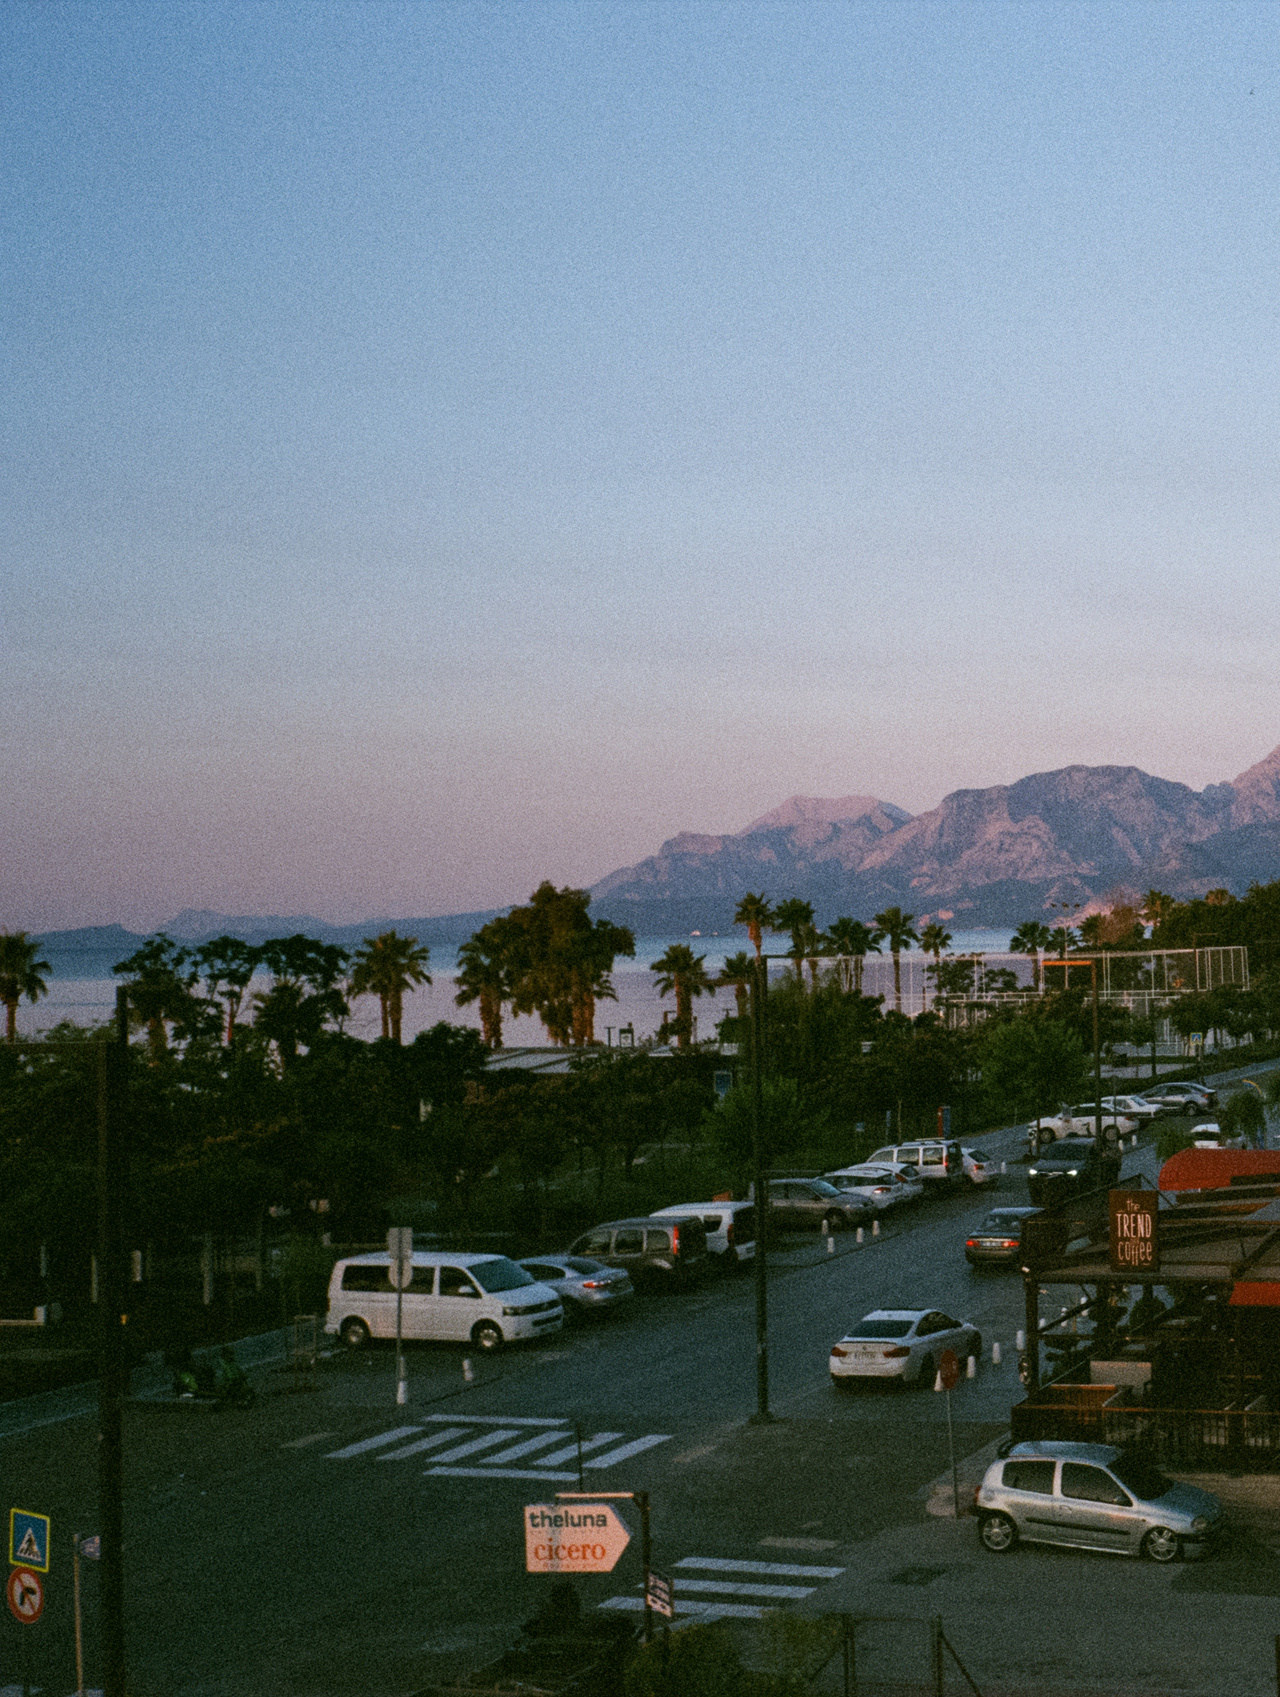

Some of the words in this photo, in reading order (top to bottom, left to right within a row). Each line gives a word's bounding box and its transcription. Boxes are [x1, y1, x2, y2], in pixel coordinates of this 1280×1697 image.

[1126, 1198, 1140, 1212] the
[1116, 1213, 1152, 1237] TREND
[1117, 1241, 1152, 1265] coffee
[529, 1510, 607, 1528] theluna
[534, 1538, 606, 1561] cicero
